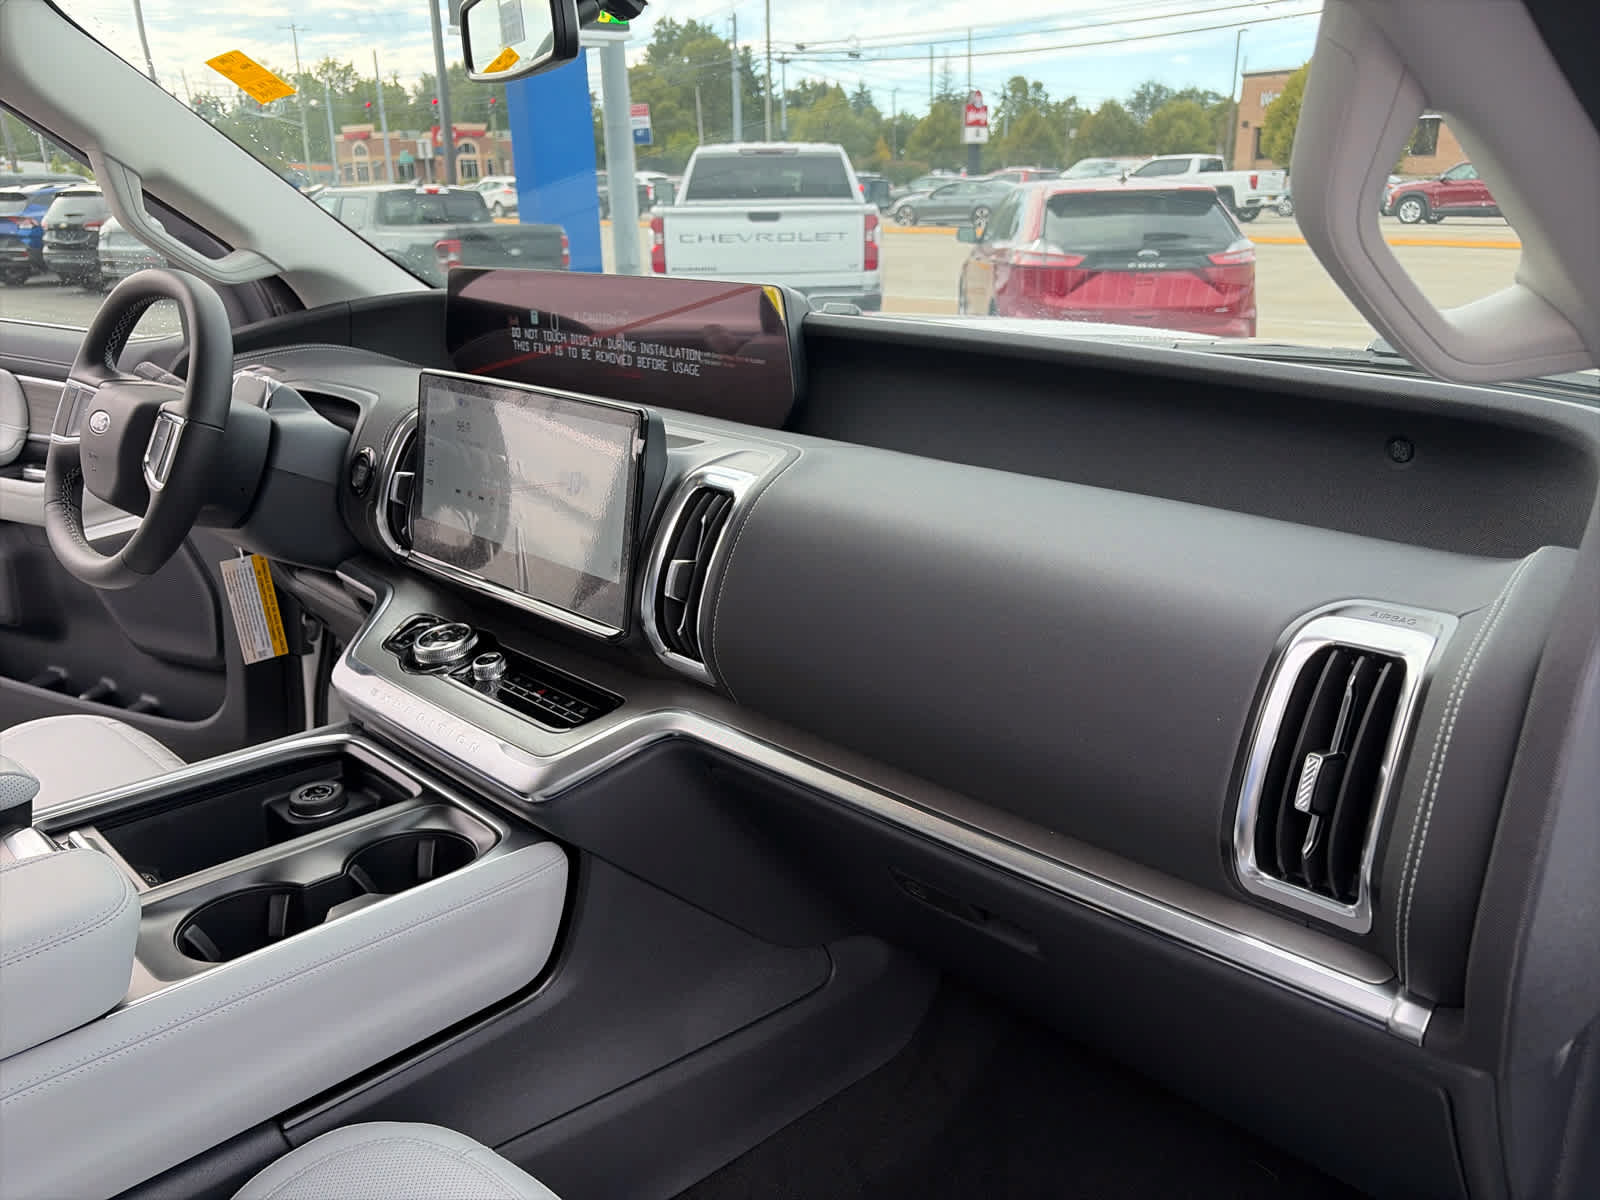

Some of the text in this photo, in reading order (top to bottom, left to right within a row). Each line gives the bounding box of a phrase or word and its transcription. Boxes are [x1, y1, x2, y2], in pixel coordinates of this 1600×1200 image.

[679, 231, 848, 244] CHEVROLET
[512, 327, 521, 338] DO
[525, 329, 539, 340] NOT
[543, 330, 567, 343] TOUCH
[570, 334, 603, 348] DISPLAY
[607, 338, 636, 352] DURING
[640, 342, 702, 361] INSTALLATION
[513, 340, 700, 376] THIS FILM IS TO BE REMOVED BEFORE USAGE
[1369, 610, 1417, 625] AIRBAG
